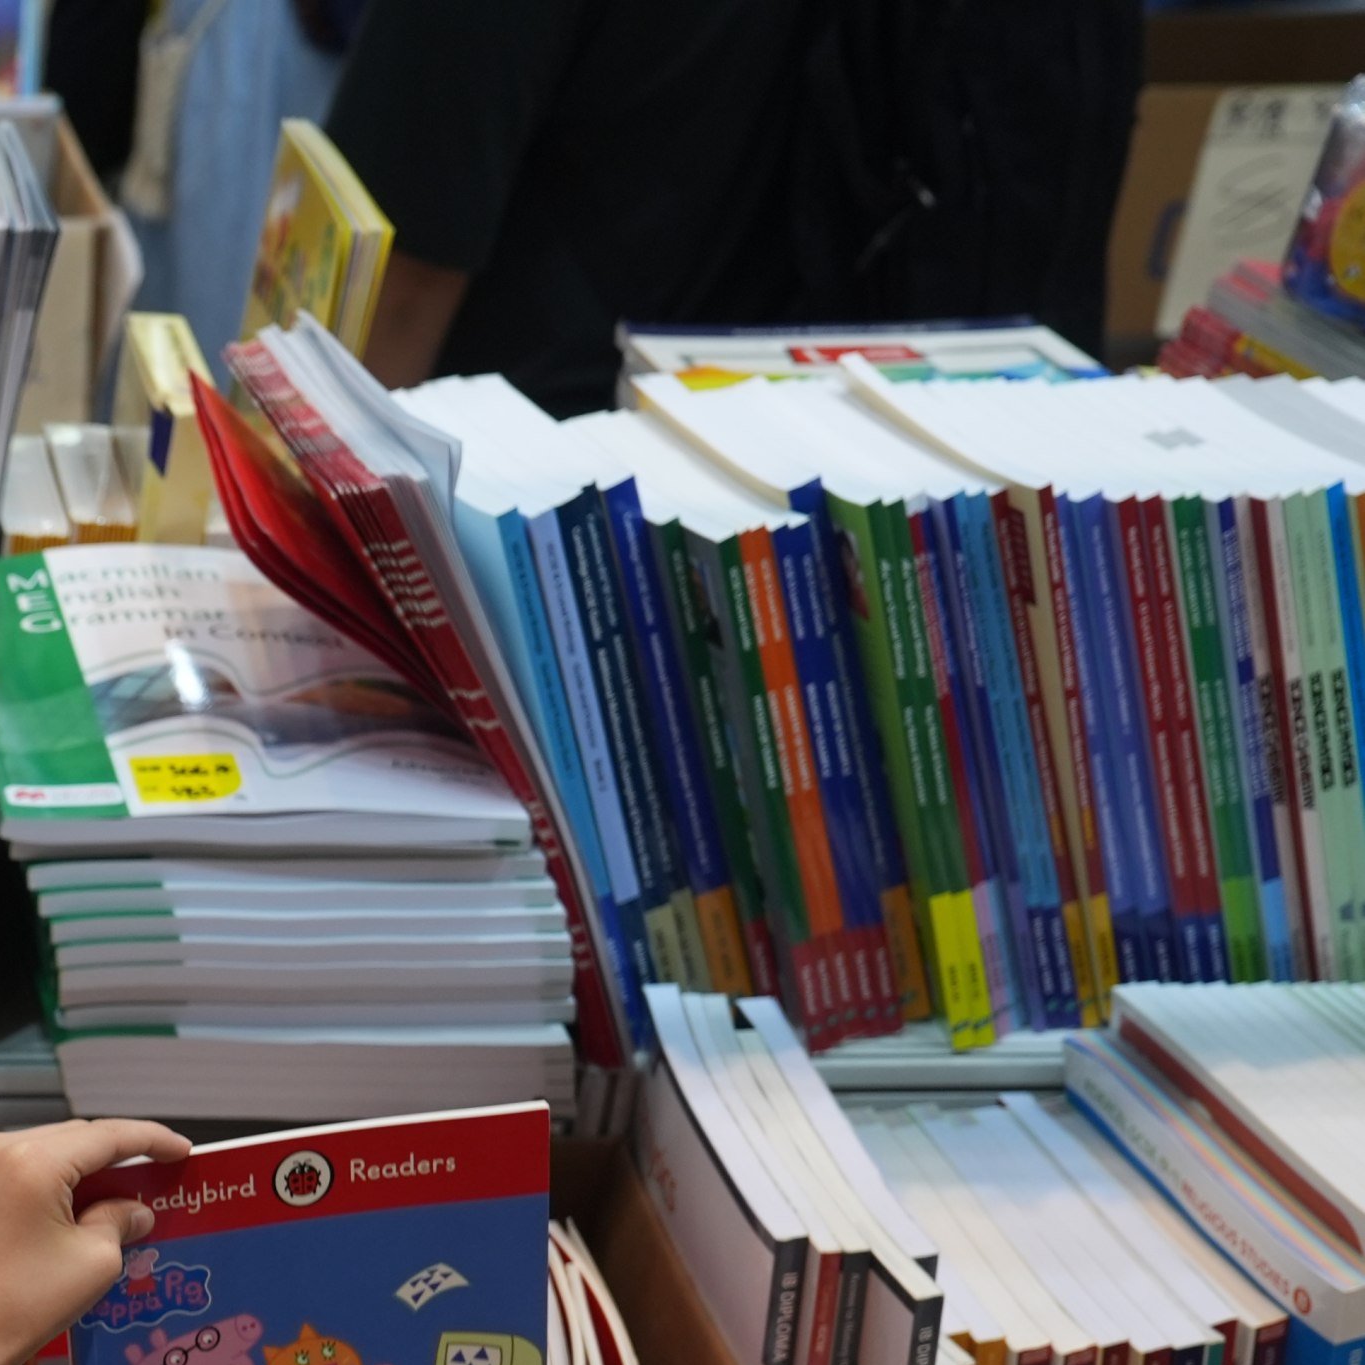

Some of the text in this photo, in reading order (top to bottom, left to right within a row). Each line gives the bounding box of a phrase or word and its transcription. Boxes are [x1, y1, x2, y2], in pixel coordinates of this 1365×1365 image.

[349, 1152, 457, 1183] Readers
[96, 1269, 204, 1326] eppa Pig
[774, 1291, 798, 1362] DIPLOMA
[916, 1324, 934, 1345] IB
